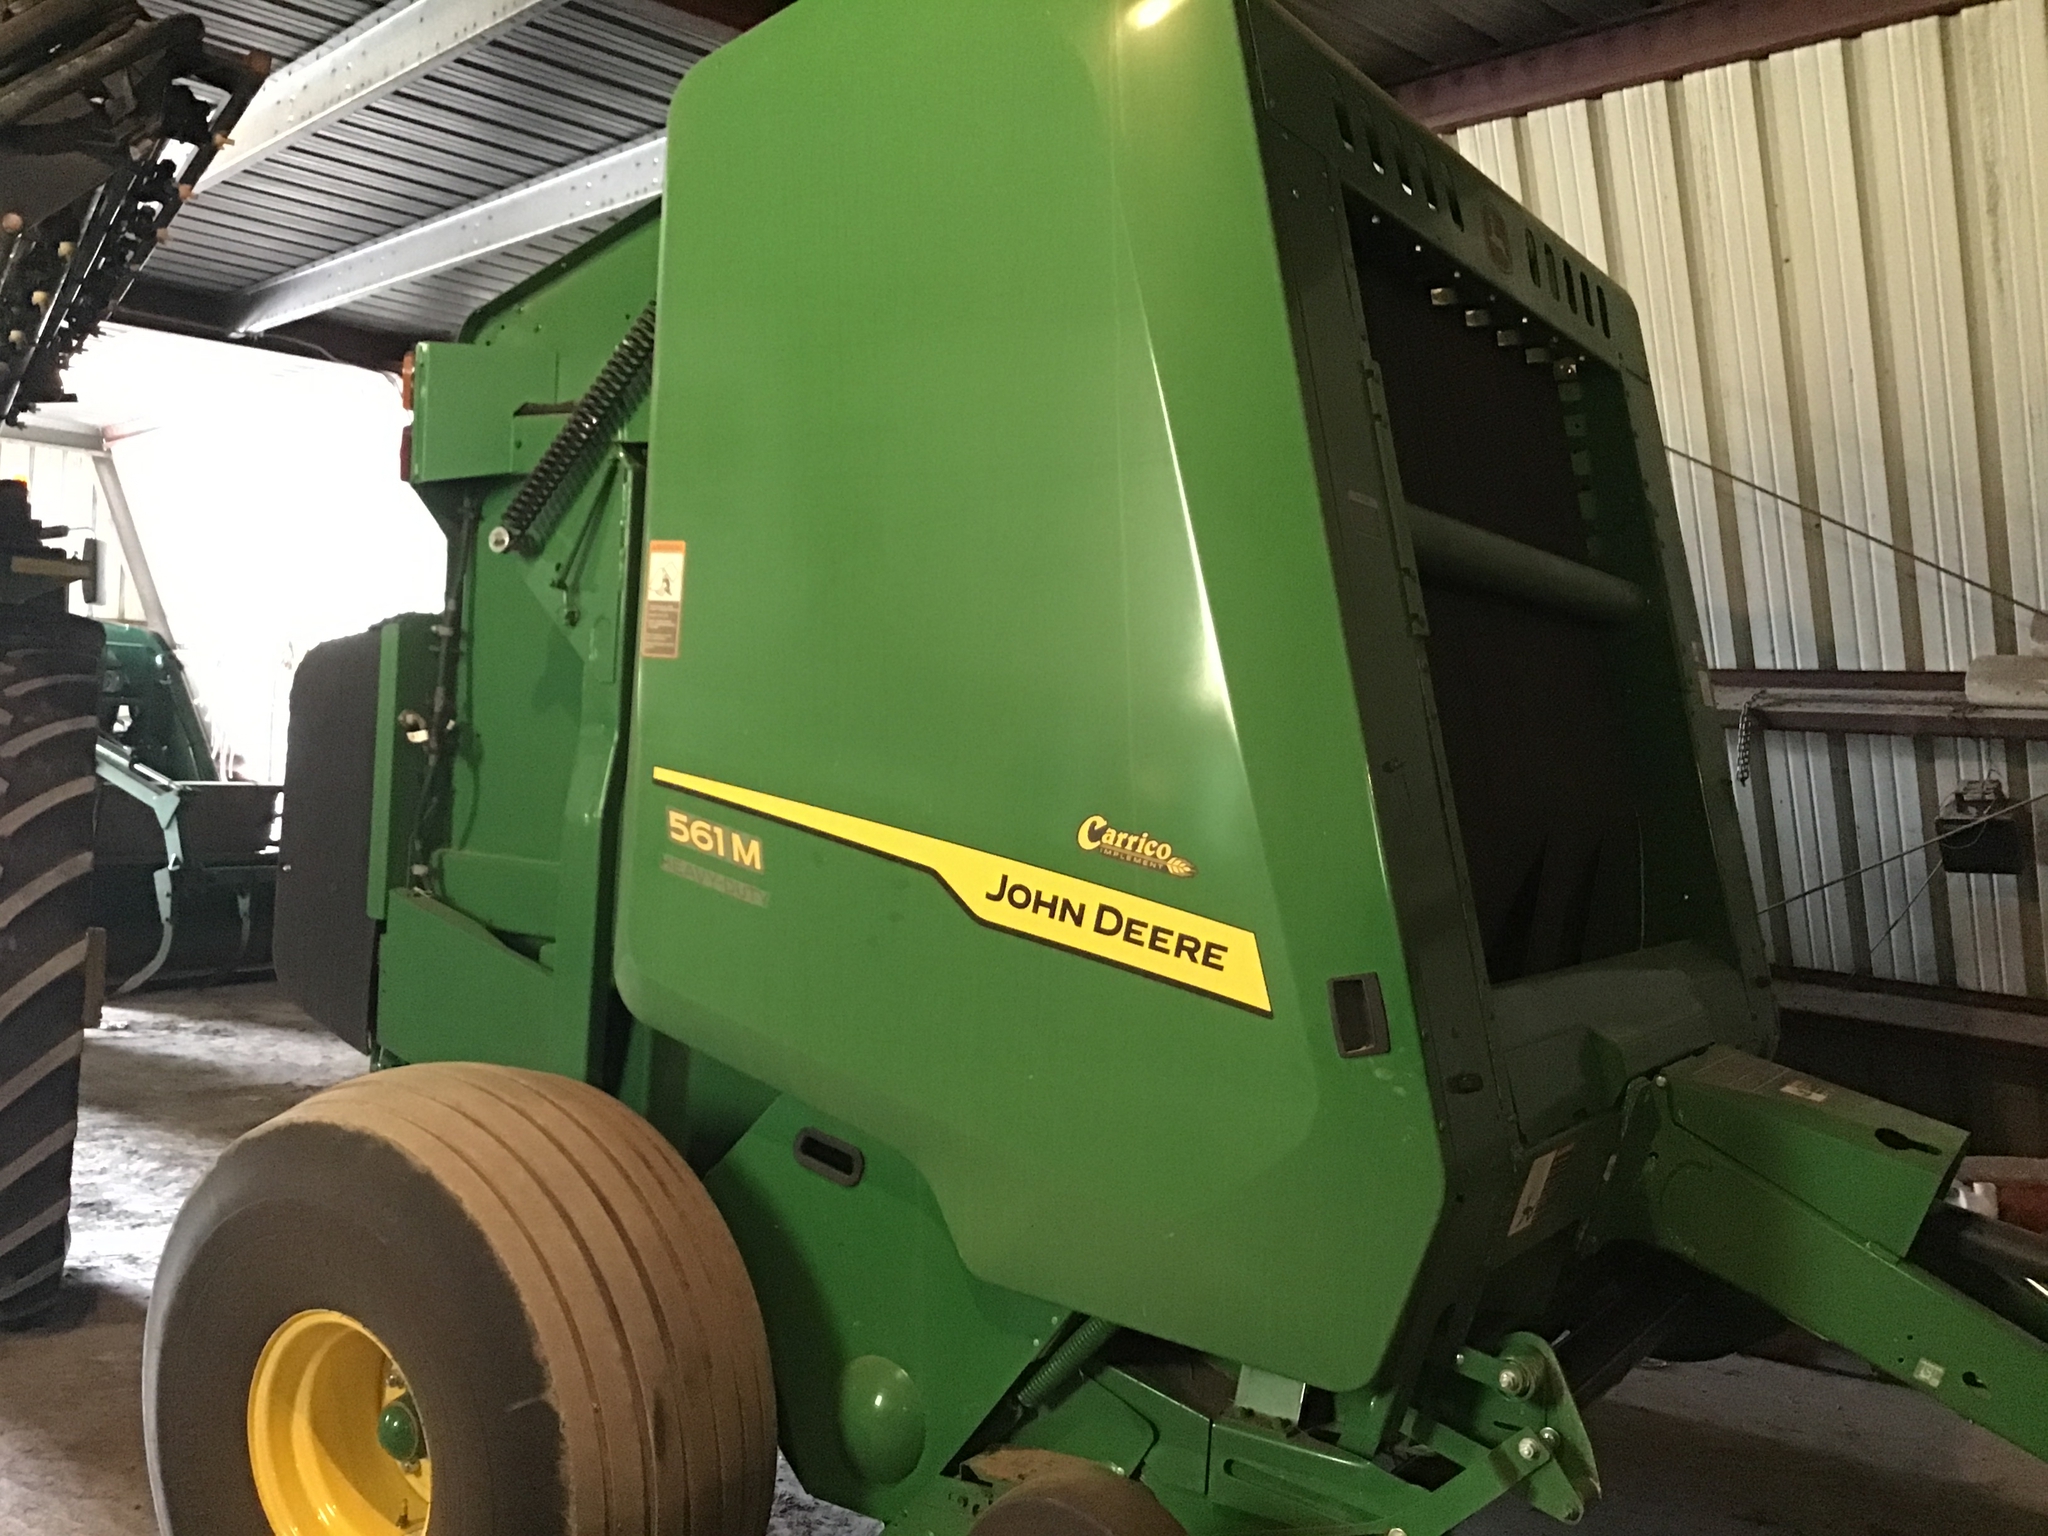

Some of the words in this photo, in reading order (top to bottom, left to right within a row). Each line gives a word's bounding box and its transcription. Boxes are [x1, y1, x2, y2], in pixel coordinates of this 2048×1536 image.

[1077, 814, 1172, 860] Carrico
[1099, 847, 1164, 870] IMPLEMENT
[985, 873, 1086, 928] JOHN
[1093, 902, 1229, 972] DEERE
